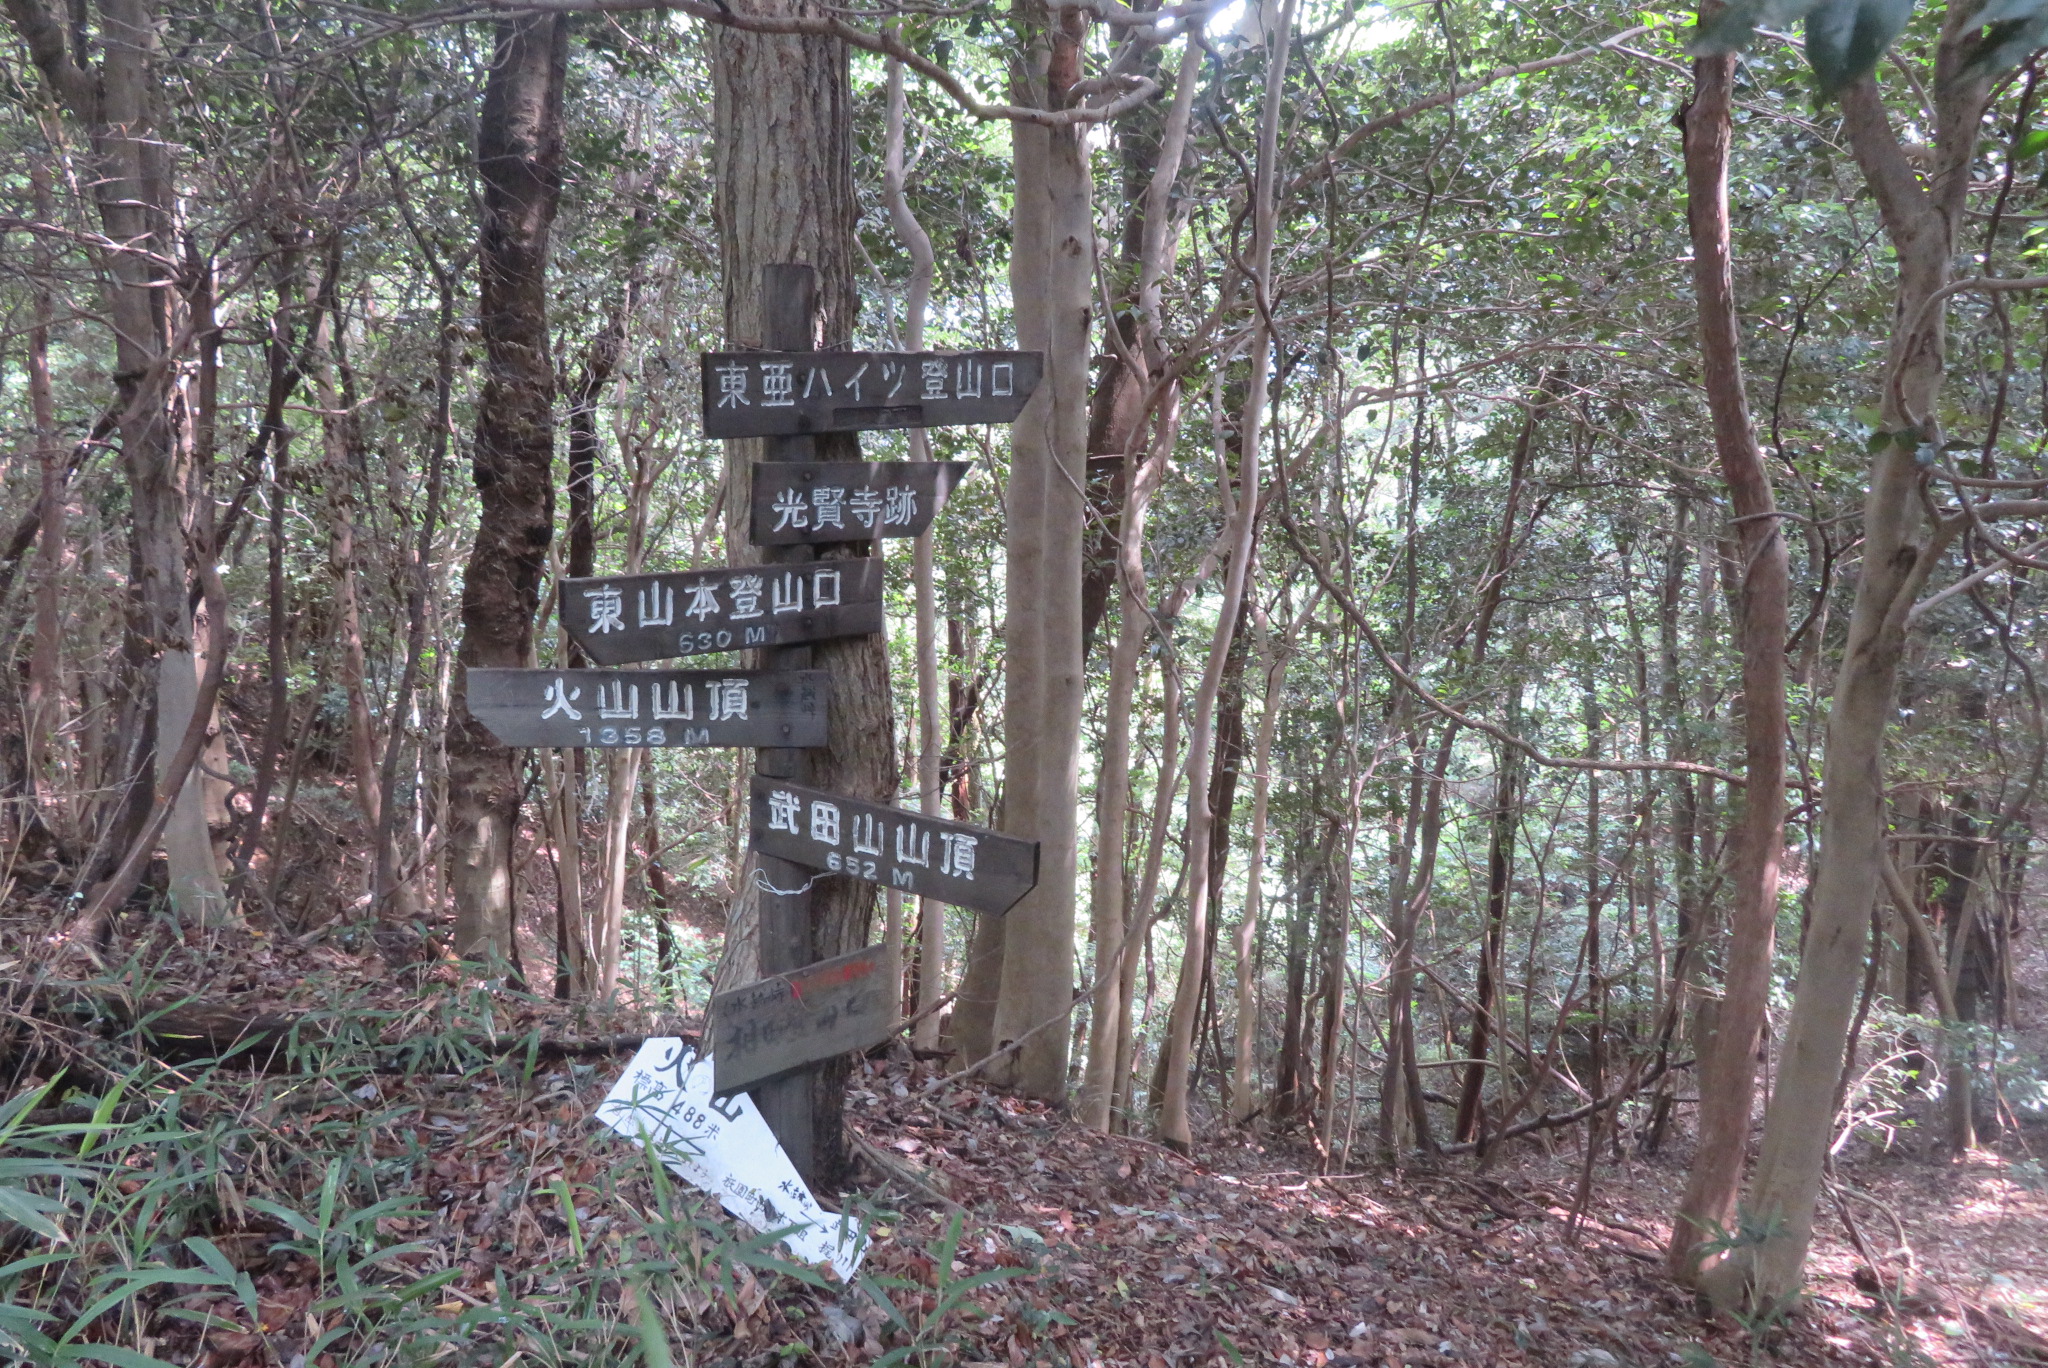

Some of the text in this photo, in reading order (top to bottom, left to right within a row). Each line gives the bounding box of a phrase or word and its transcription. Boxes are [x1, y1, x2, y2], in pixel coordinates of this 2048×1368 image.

[714, 359, 1014, 409] 東亜ハイツ登山口
[772, 484, 918, 533] 光賢寺跡
[583, 568, 841, 635] 東山本登山口
[678, 626, 766, 654] 630 M
[541, 676, 750, 722] 火山山頂
[578, 726, 710, 746] 1358 M
[768, 789, 979, 882] 武田山山頂
[826, 851, 914, 891] 652 M
